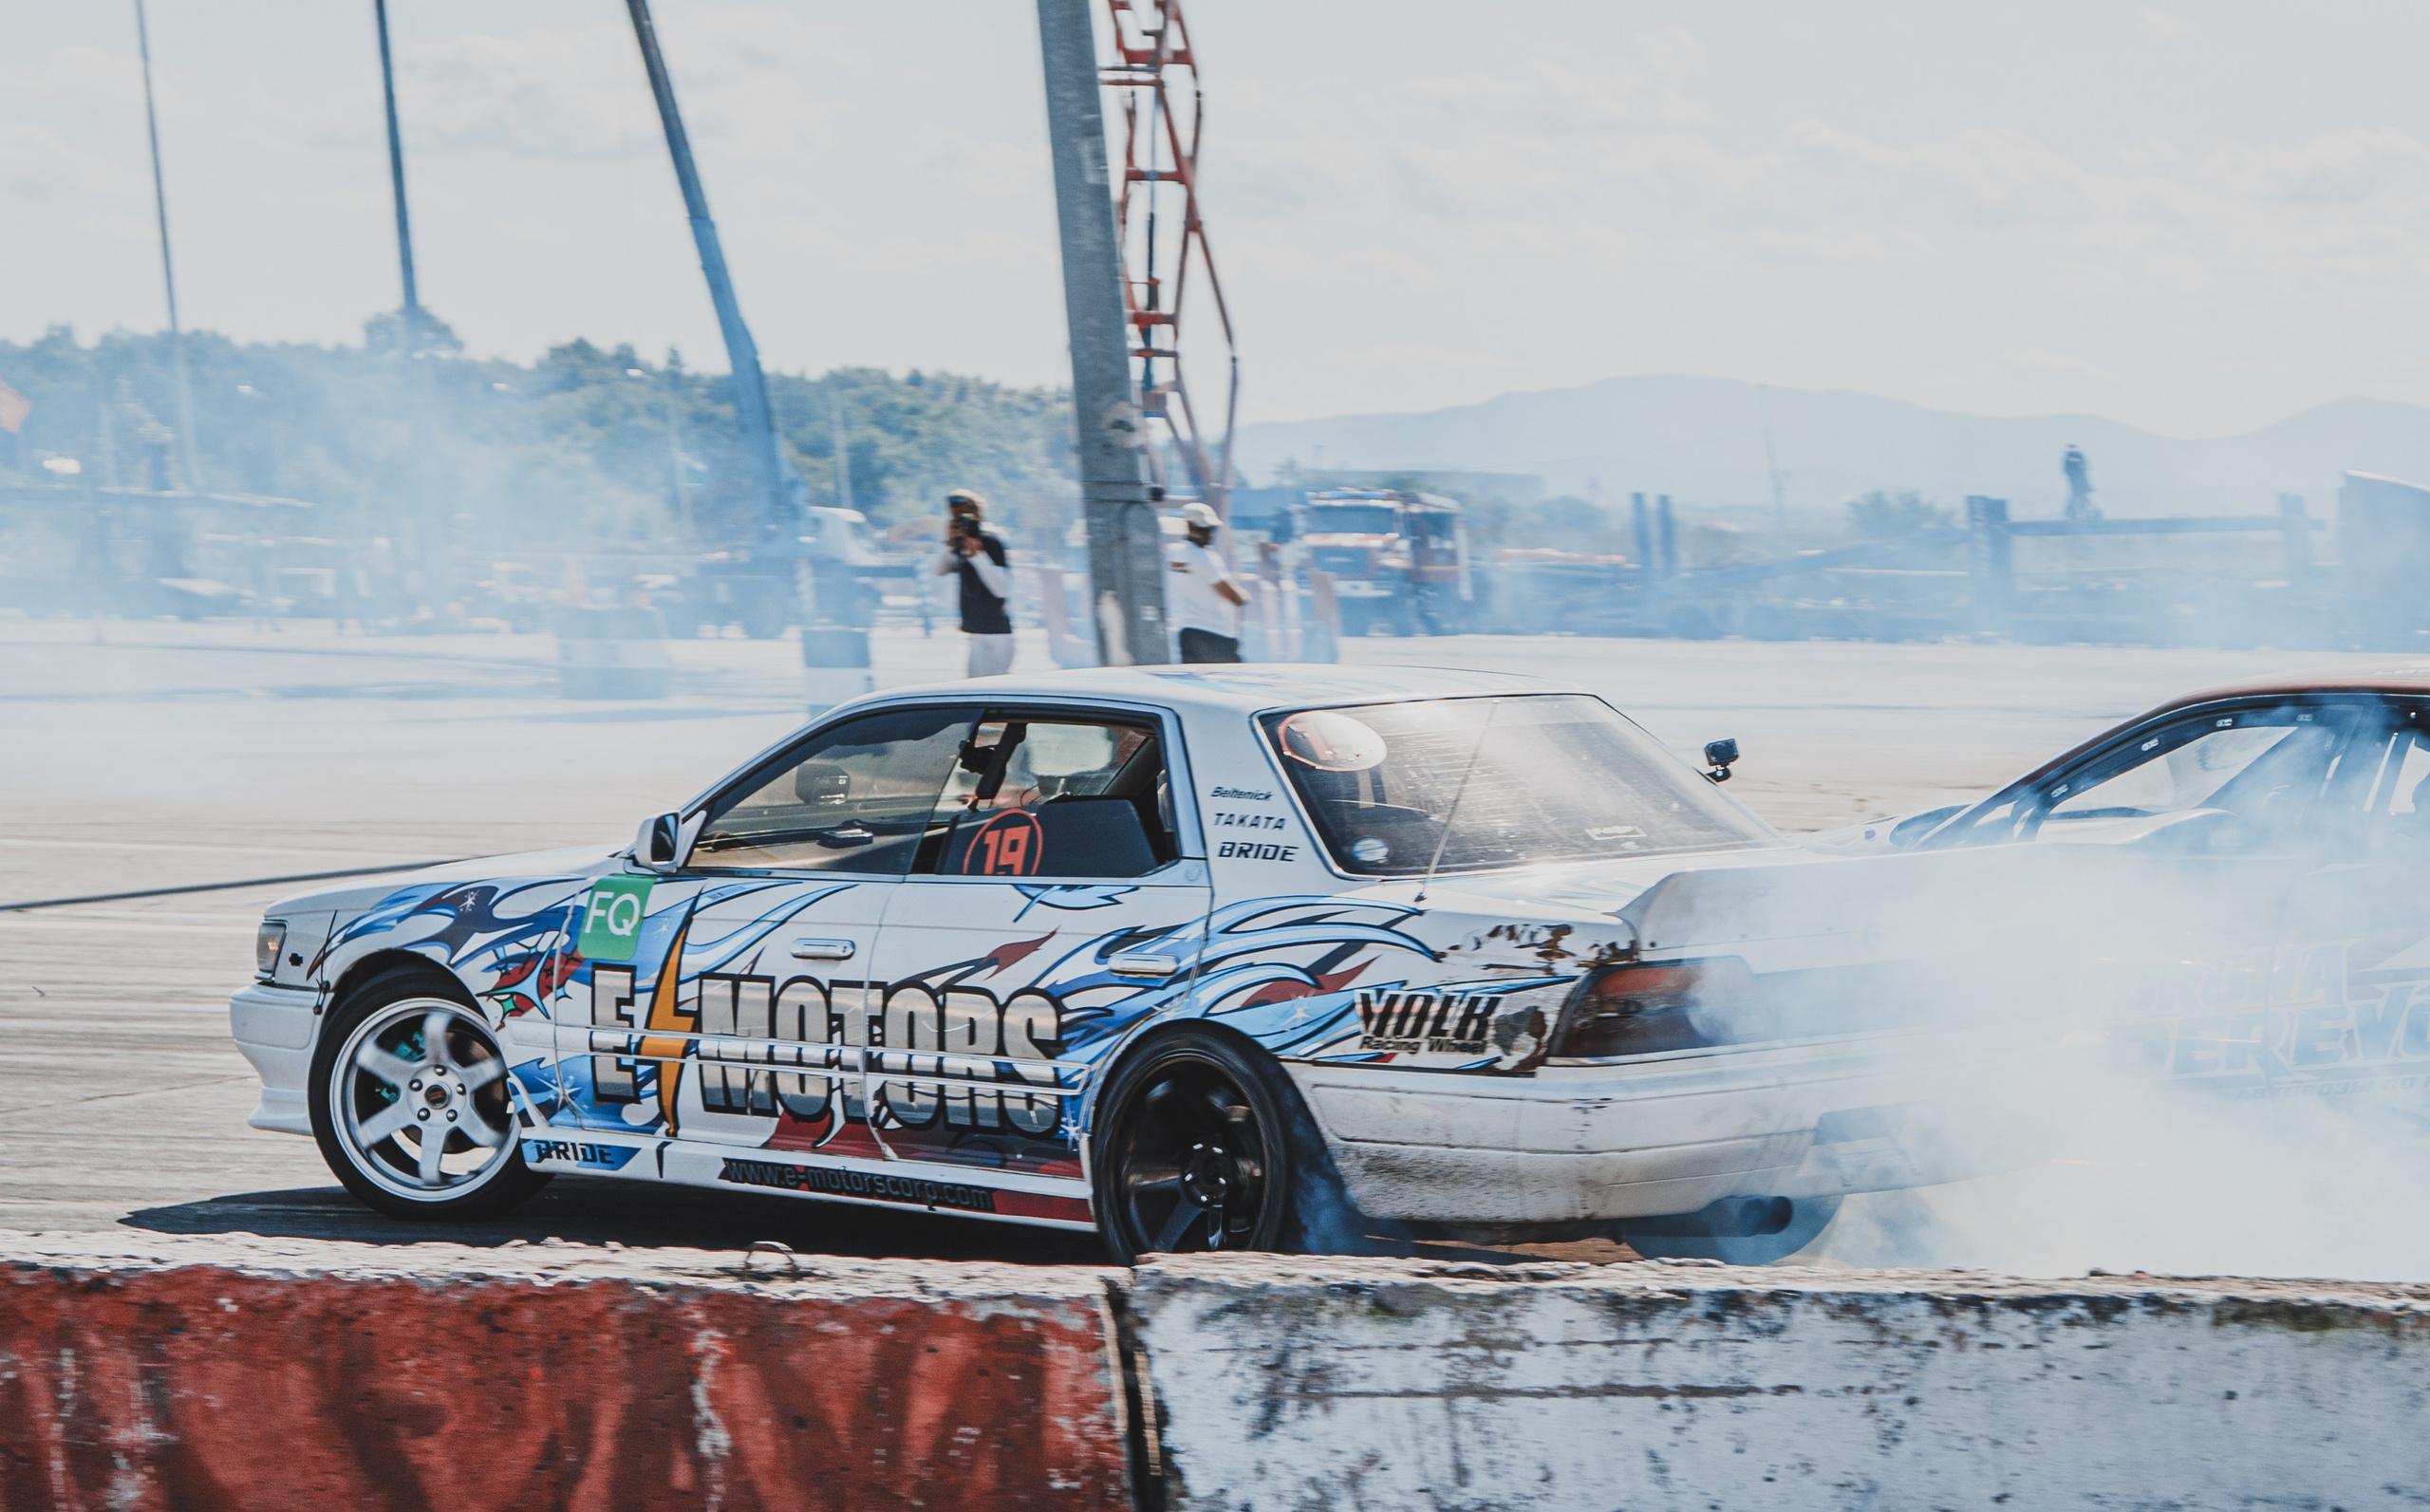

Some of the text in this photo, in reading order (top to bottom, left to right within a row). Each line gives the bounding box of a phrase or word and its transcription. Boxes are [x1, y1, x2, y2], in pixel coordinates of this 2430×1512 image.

[1214, 812, 1286, 831] TAKATA
[983, 825, 1032, 875] 19
[1218, 841, 1299, 862] BRIDE
[584, 890, 641, 936] FQ
[1356, 990, 1505, 1041] VOLK
[1359, 1035, 1422, 1055] Racing
[724, 1159, 994, 1210] www.e-motorscorp.com
